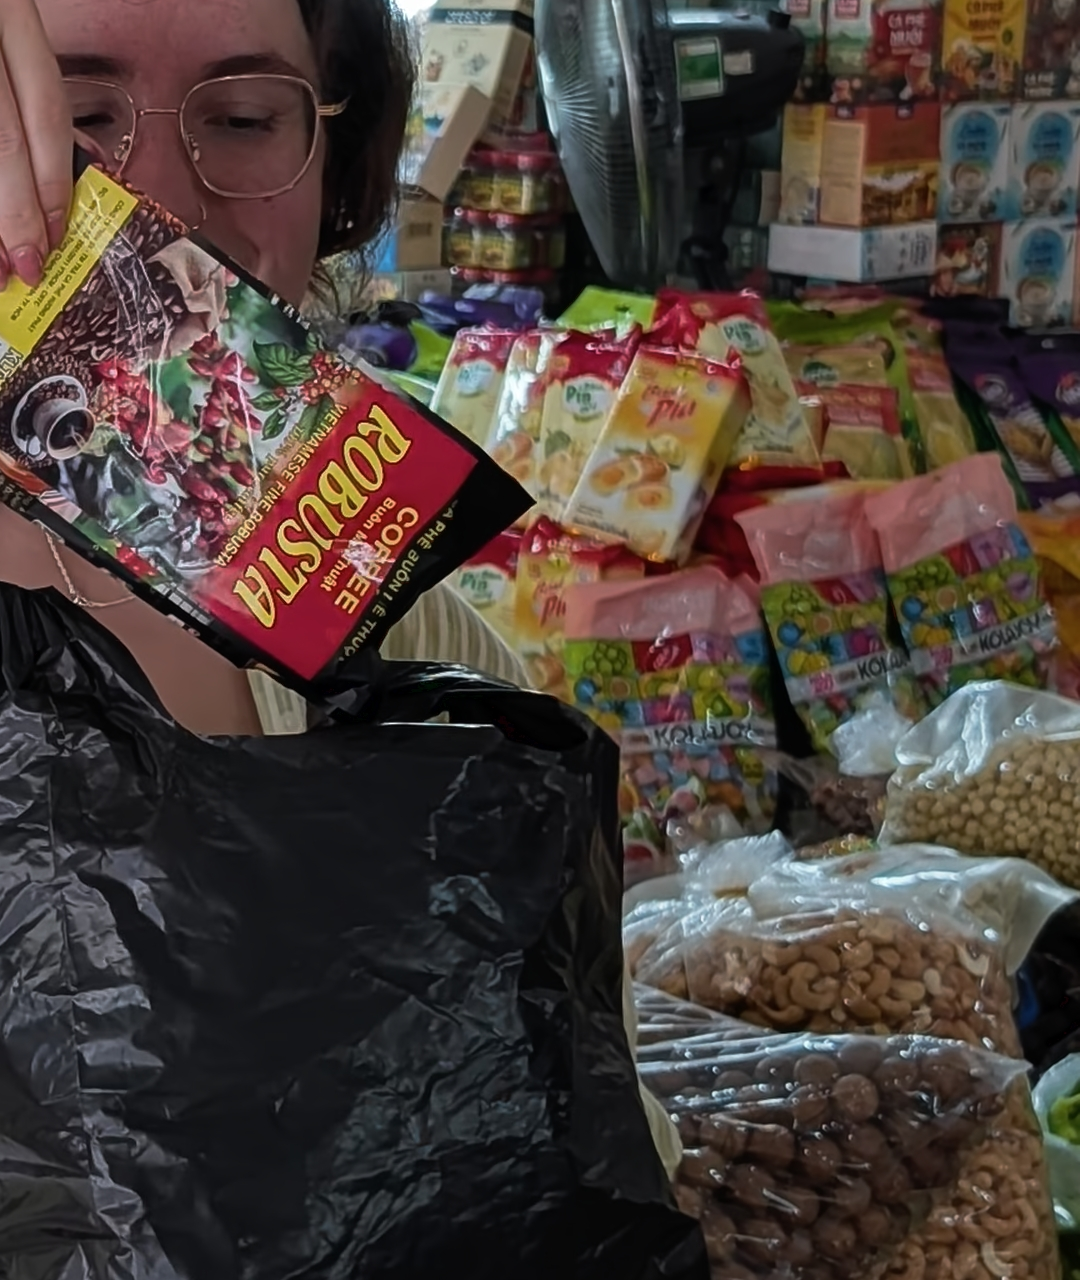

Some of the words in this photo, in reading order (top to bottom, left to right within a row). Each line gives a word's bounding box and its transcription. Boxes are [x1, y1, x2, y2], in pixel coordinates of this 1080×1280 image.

[279, 398, 348, 485] VIETNAMESE
[231, 402, 412, 629] ROBUSTA
[257, 479, 286, 513] FINE
[361, 493, 396, 534] Buôn
[212, 507, 263, 569] ROBUSTA
[333, 505, 419, 614] COFFEE
